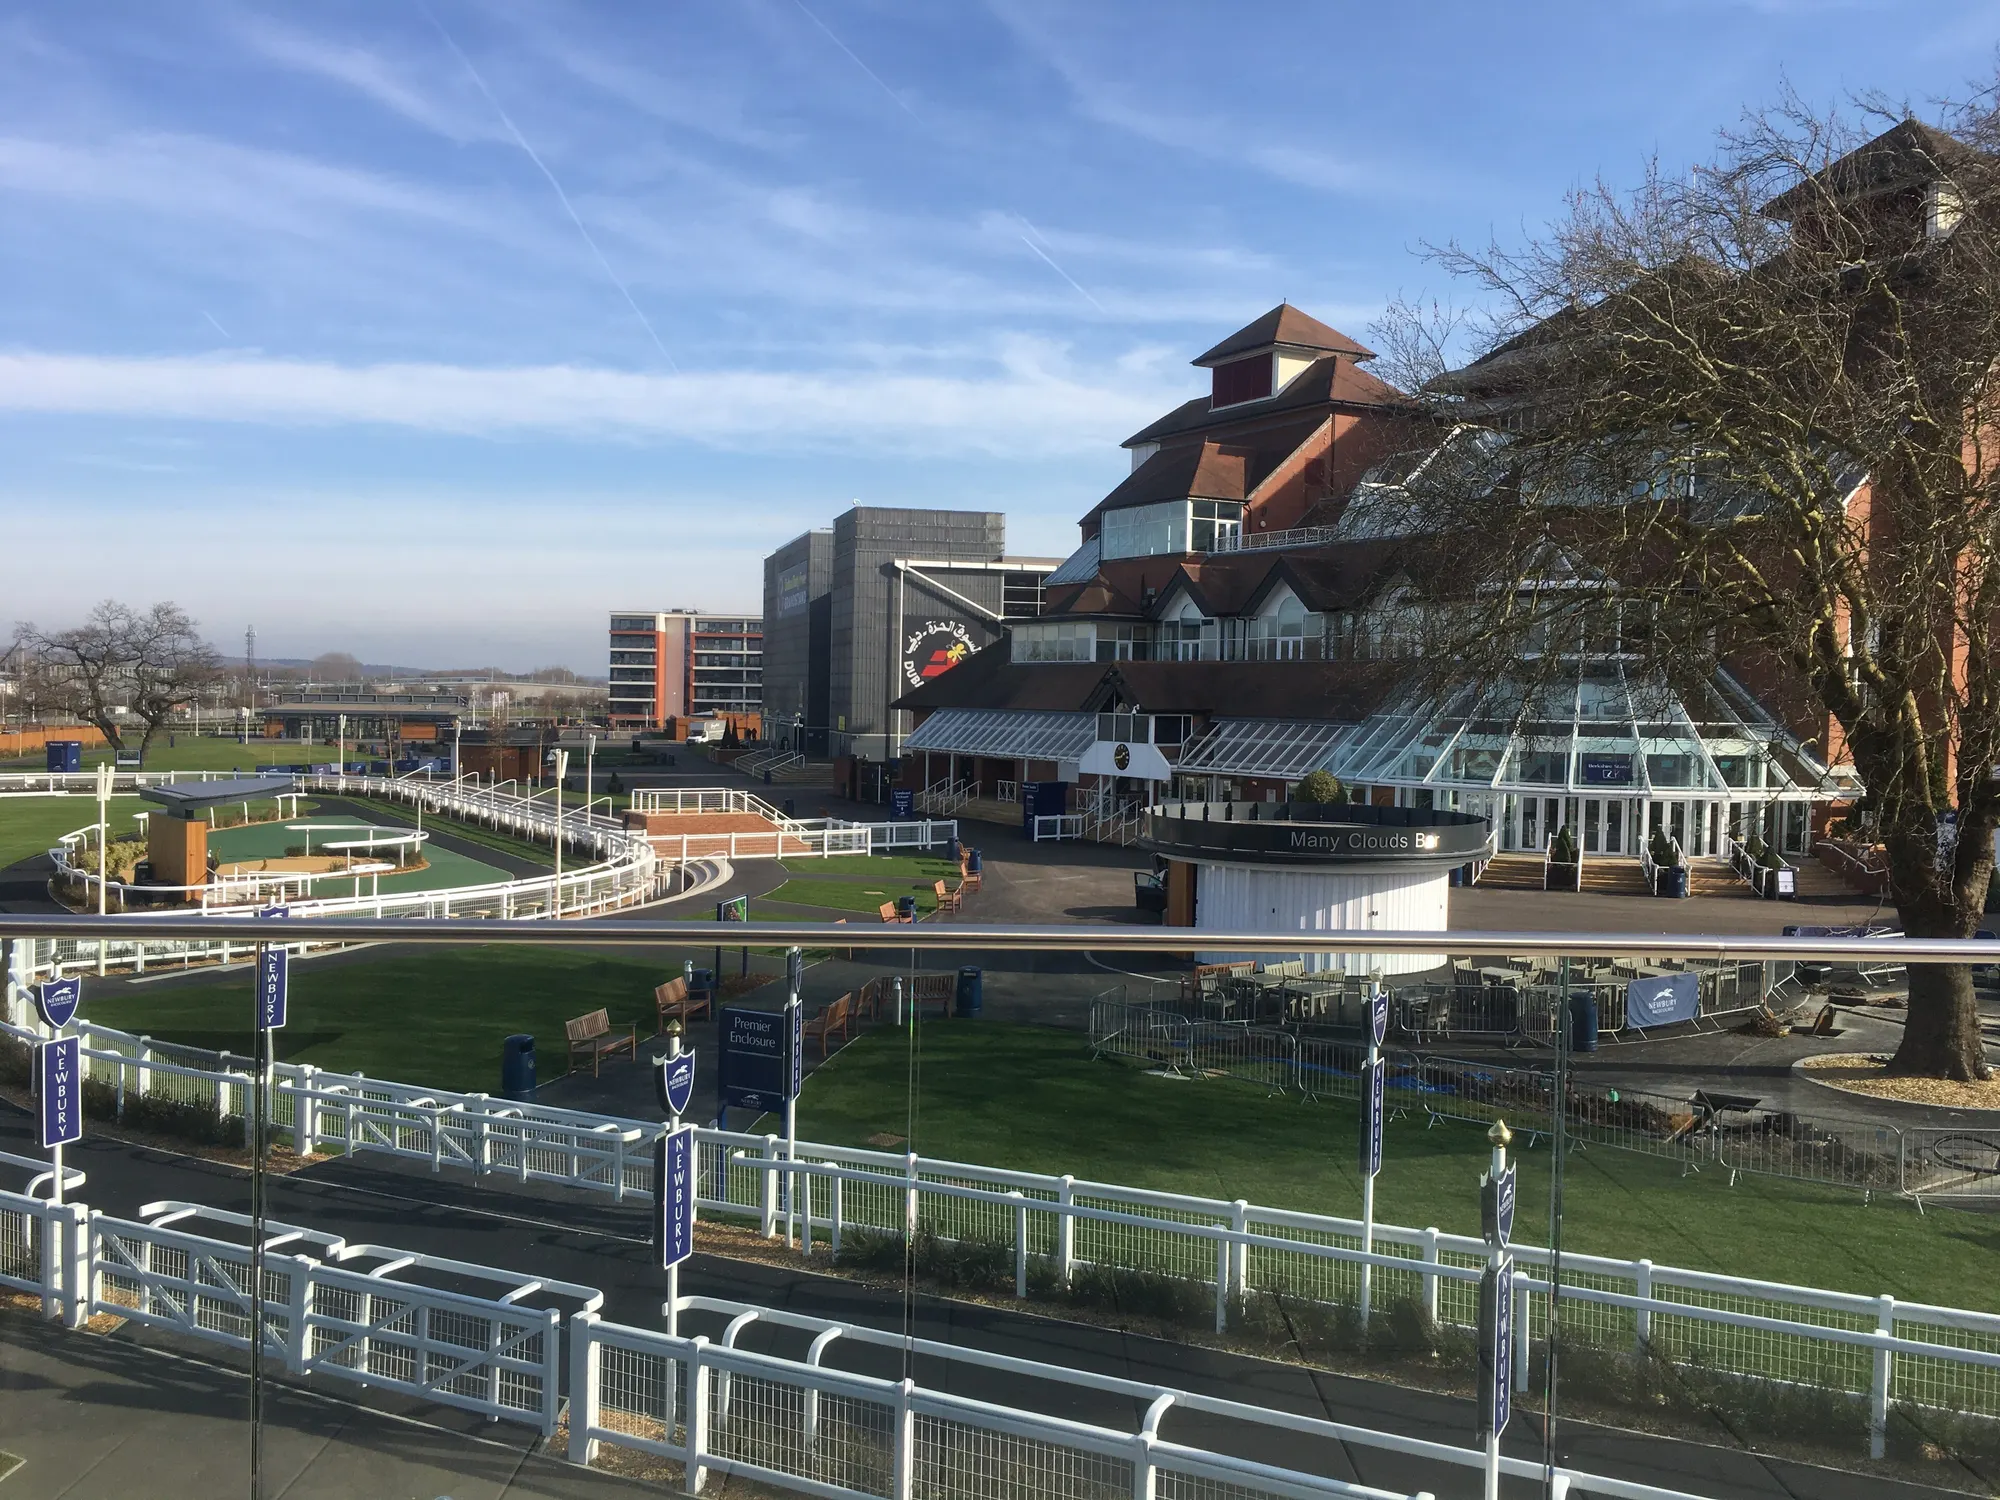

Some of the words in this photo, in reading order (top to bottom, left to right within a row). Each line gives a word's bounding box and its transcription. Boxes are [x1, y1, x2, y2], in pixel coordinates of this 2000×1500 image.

[1290, 831, 1340, 852] Many
[1348, 832, 1408, 849] Clouds
[1415, 832, 1440, 849] Br
[267, 953, 279, 1023] NEWBURY
[47, 993, 76, 1004] NEWBURY
[1648, 998, 1677, 1010] NEWBURY
[734, 1016, 772, 1032] Premier
[730, 1031, 776, 1048] Enclosure
[668, 1072, 691, 1086] NEWBURY
[55, 1043, 69, 1137] NEWBURY
[674, 1136, 685, 1254] NEWBURY
[1498, 1271, 1508, 1422] NEWBURY
